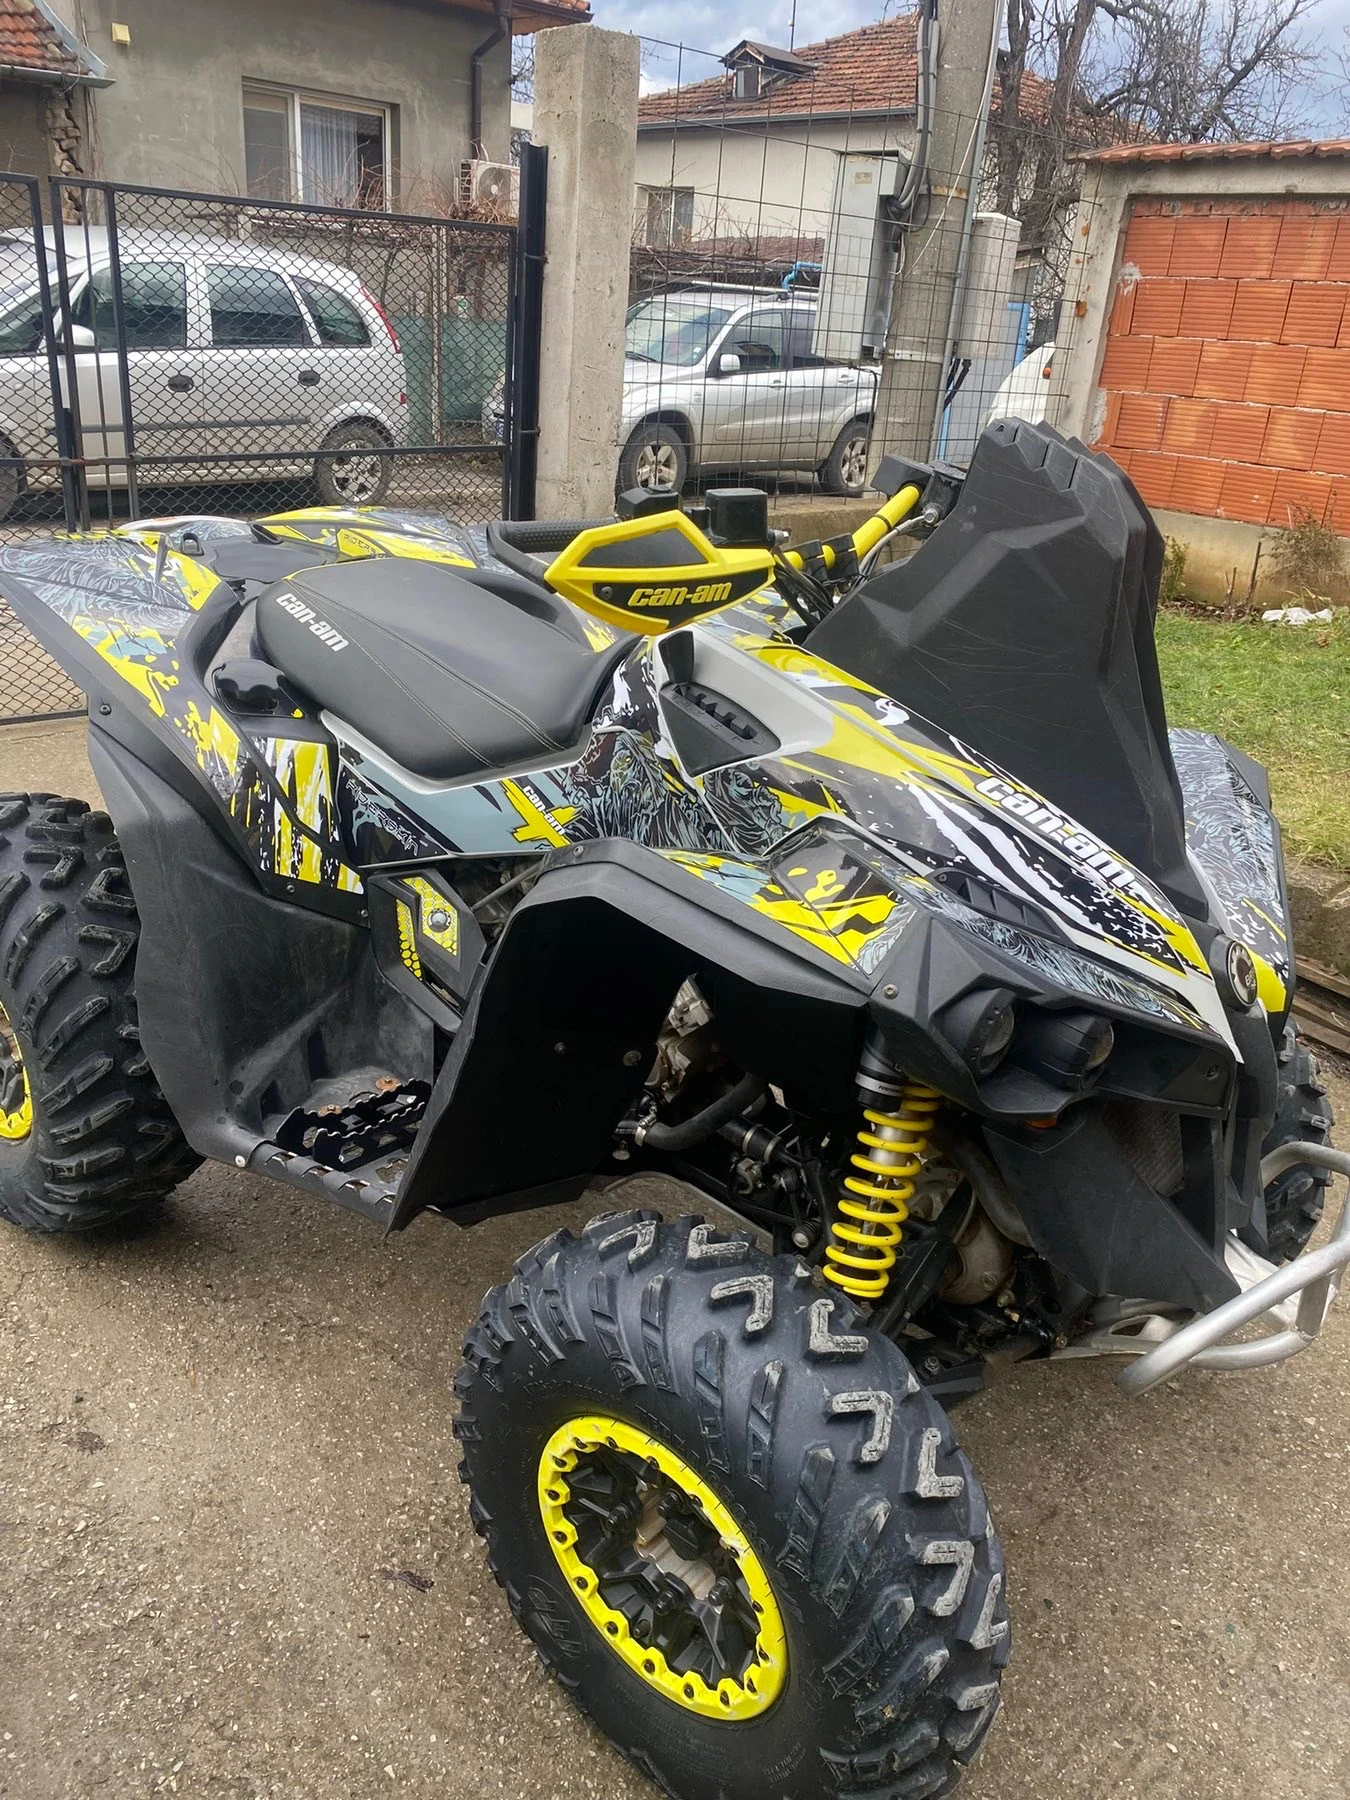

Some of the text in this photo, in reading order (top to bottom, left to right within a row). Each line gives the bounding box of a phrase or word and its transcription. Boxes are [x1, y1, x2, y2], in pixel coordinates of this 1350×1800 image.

[627, 582, 732, 607] can-am
[276, 593, 349, 652] can-am
[523, 785, 566, 836] can-am
[975, 776, 1136, 888] can-am
